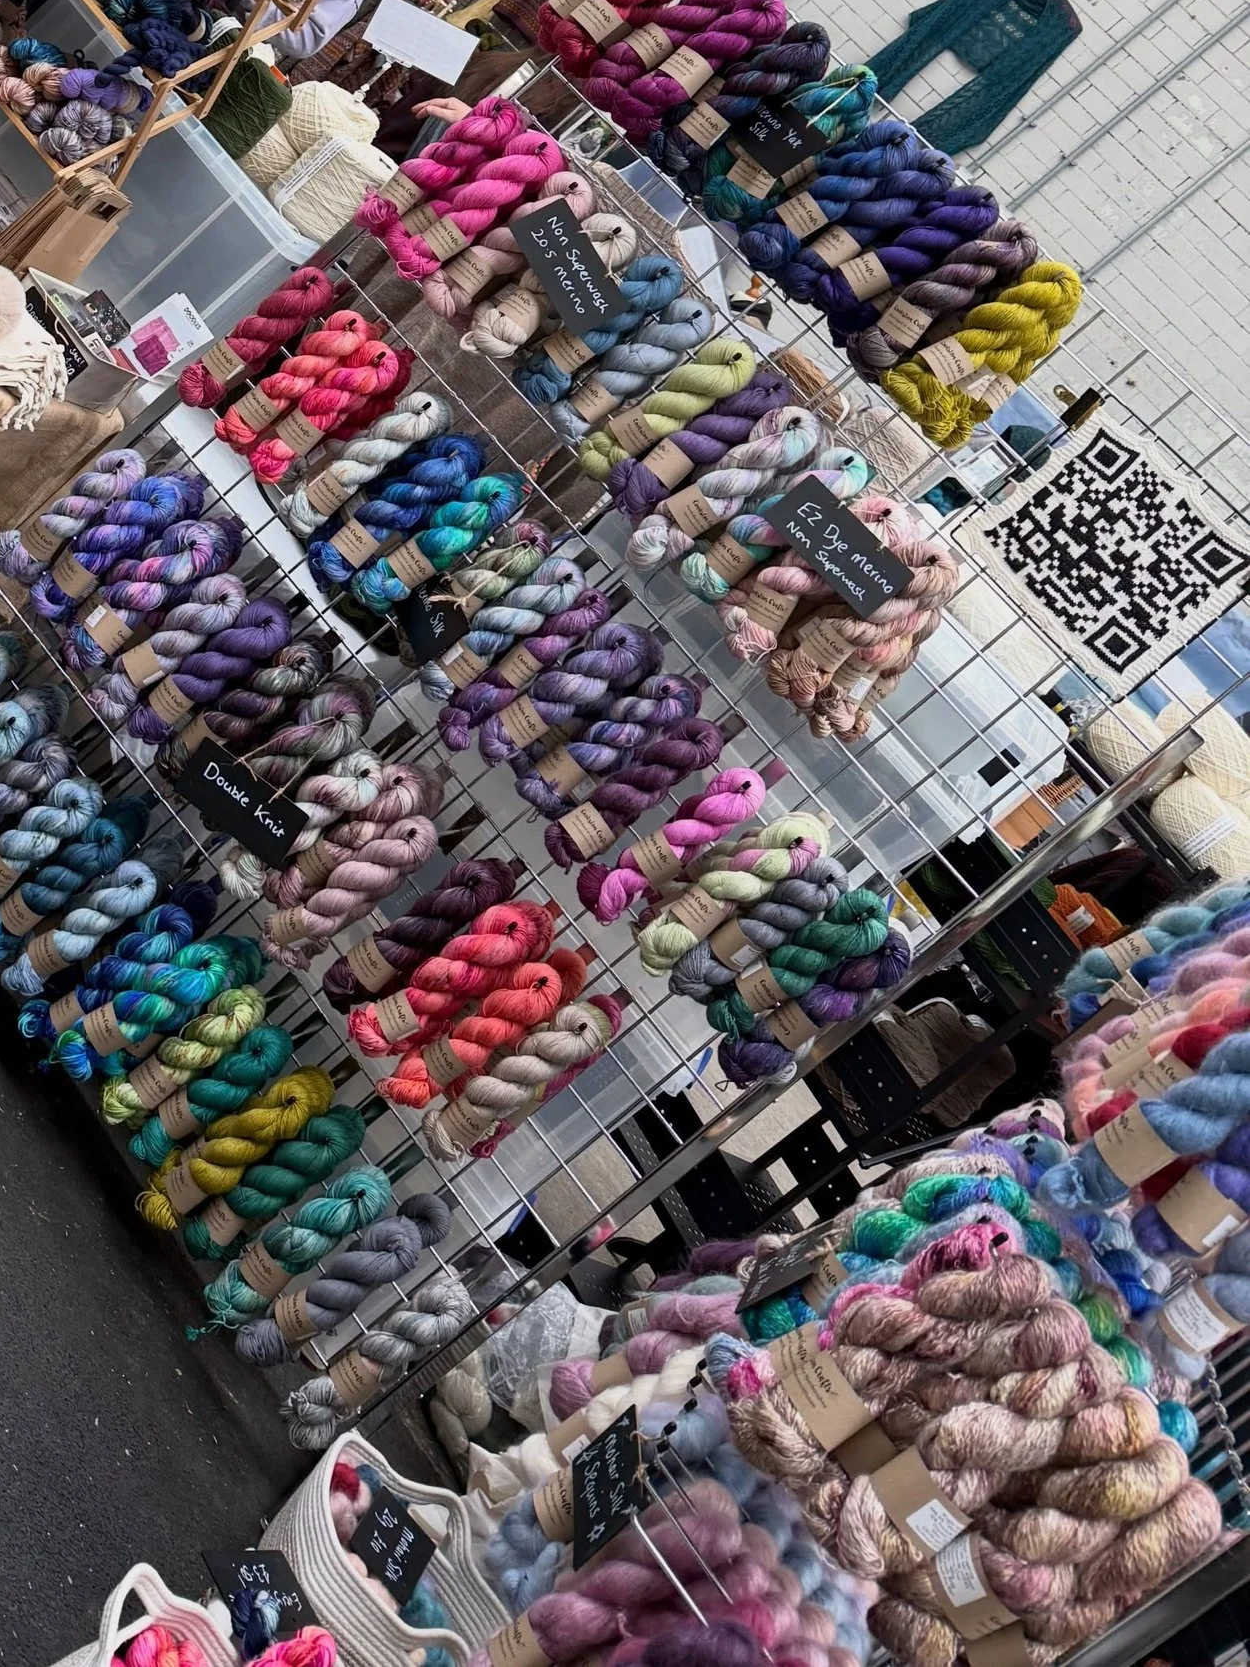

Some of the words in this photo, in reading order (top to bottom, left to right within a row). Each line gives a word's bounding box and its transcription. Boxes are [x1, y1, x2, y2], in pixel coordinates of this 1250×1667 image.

[749, 121, 770, 142] Silk
[782, 128, 803, 149] Yak
[547, 216, 569, 246] Non
[566, 249, 609, 314] Superwash
[796, 502, 823, 527] EZ
[822, 524, 849, 553] Dye
[786, 521, 811, 549] Non
[815, 550, 867, 602] Superwash
[203, 761, 250, 807] Double
[254, 804, 285, 838] Knit
[580, 1461, 601, 1519] Sequins
[375, 1508, 398, 1528] 20g
[384, 1557, 403, 1582] Silk
